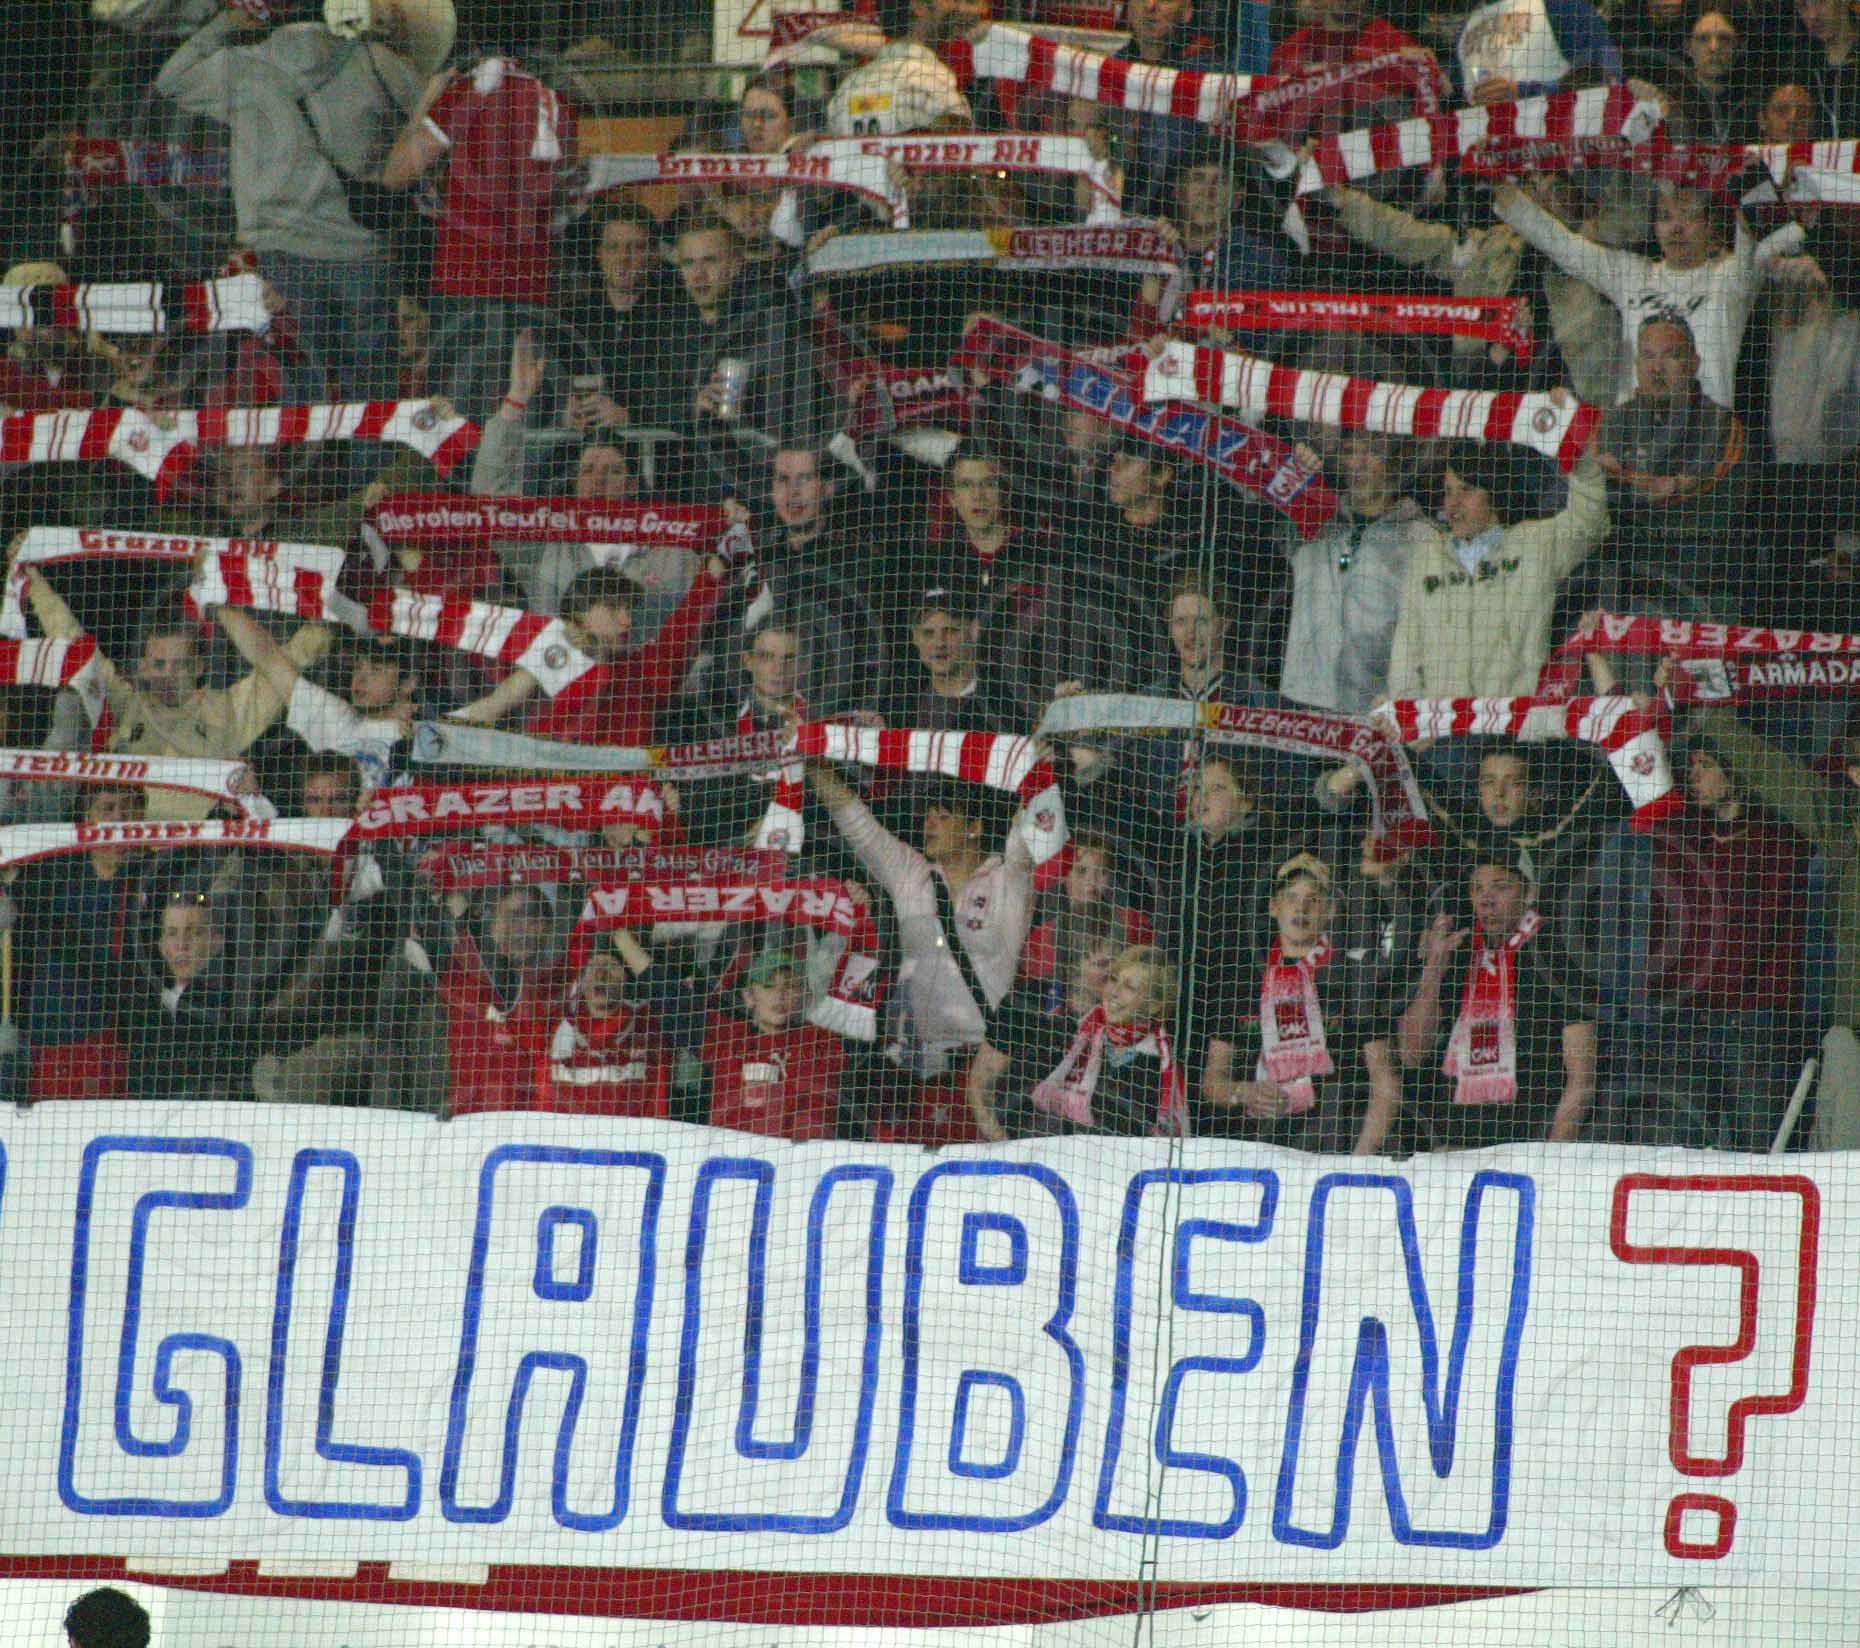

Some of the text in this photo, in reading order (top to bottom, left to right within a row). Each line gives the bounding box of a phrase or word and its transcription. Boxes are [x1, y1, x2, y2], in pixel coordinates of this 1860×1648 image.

[379, 506, 699, 537] Die roten Teufel aus Graz
[359, 783, 583, 829] GRAZER
[58, 1136, 1820, 1559] GLAUBEN ?
